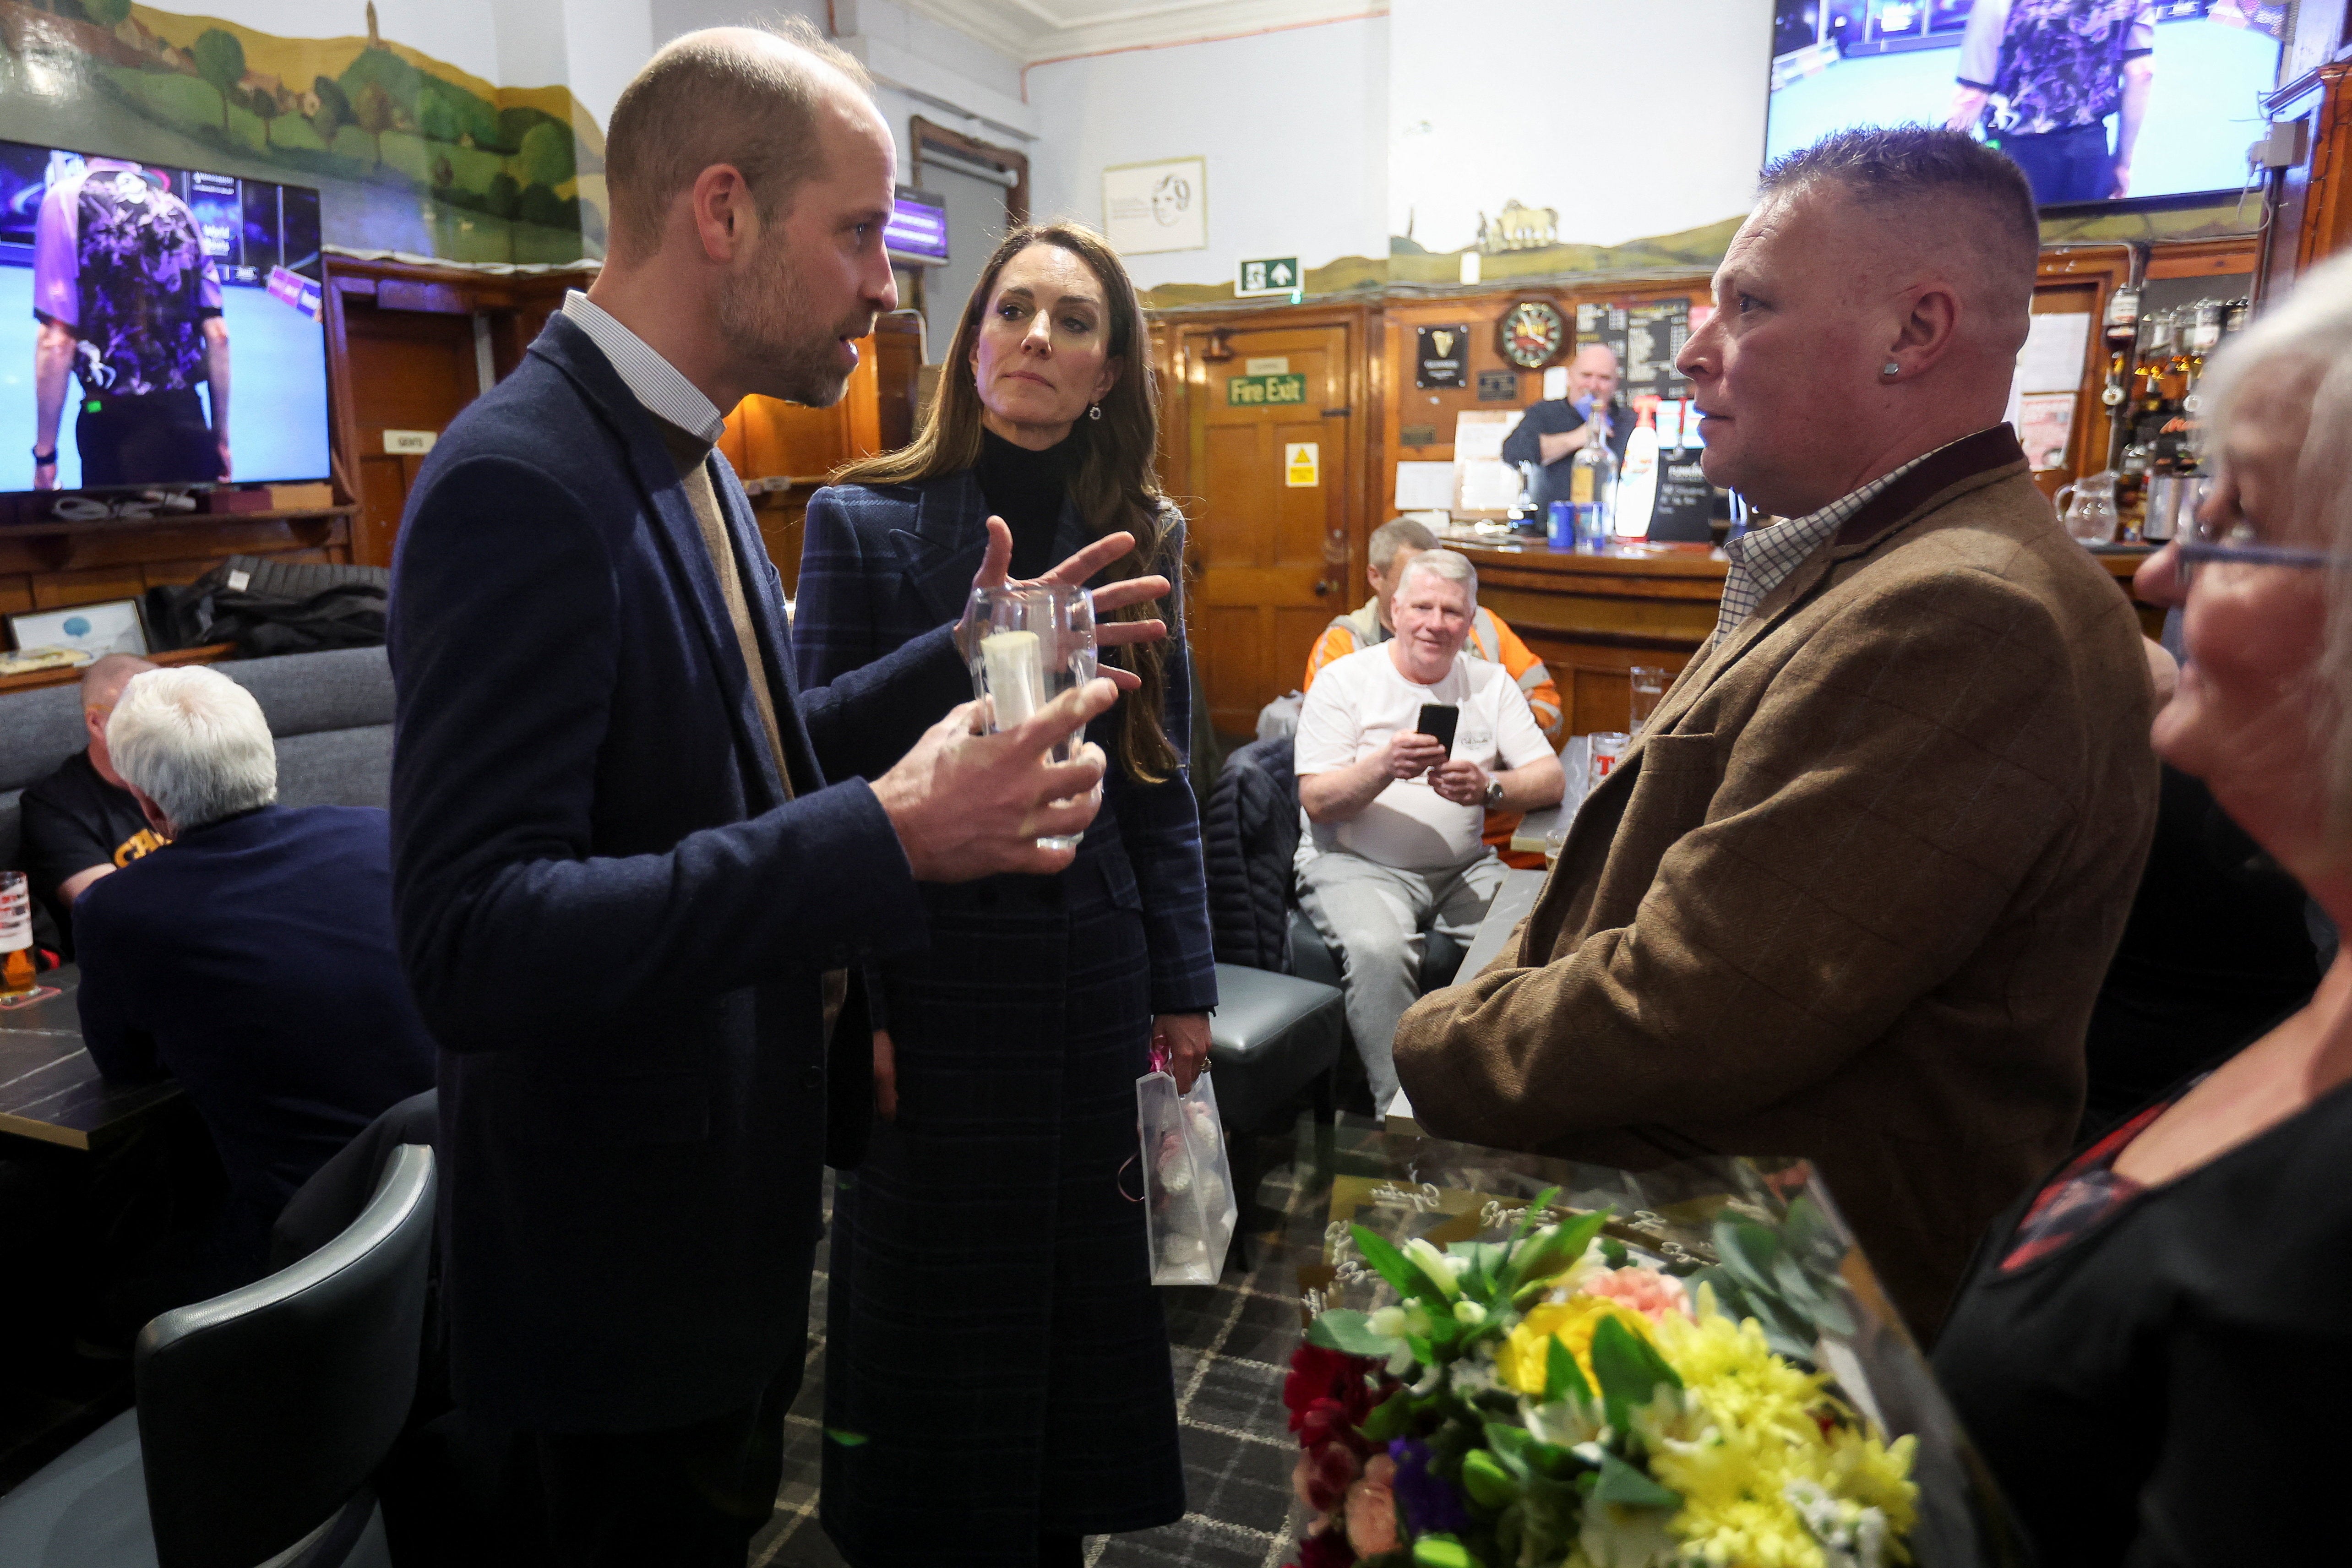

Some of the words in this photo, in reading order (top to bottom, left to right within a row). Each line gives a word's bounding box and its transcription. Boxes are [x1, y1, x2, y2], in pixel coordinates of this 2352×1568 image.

[1231, 379, 1264, 403] Fire
[1266, 376, 1301, 402] Exit
[1596, 755, 1616, 776] T
